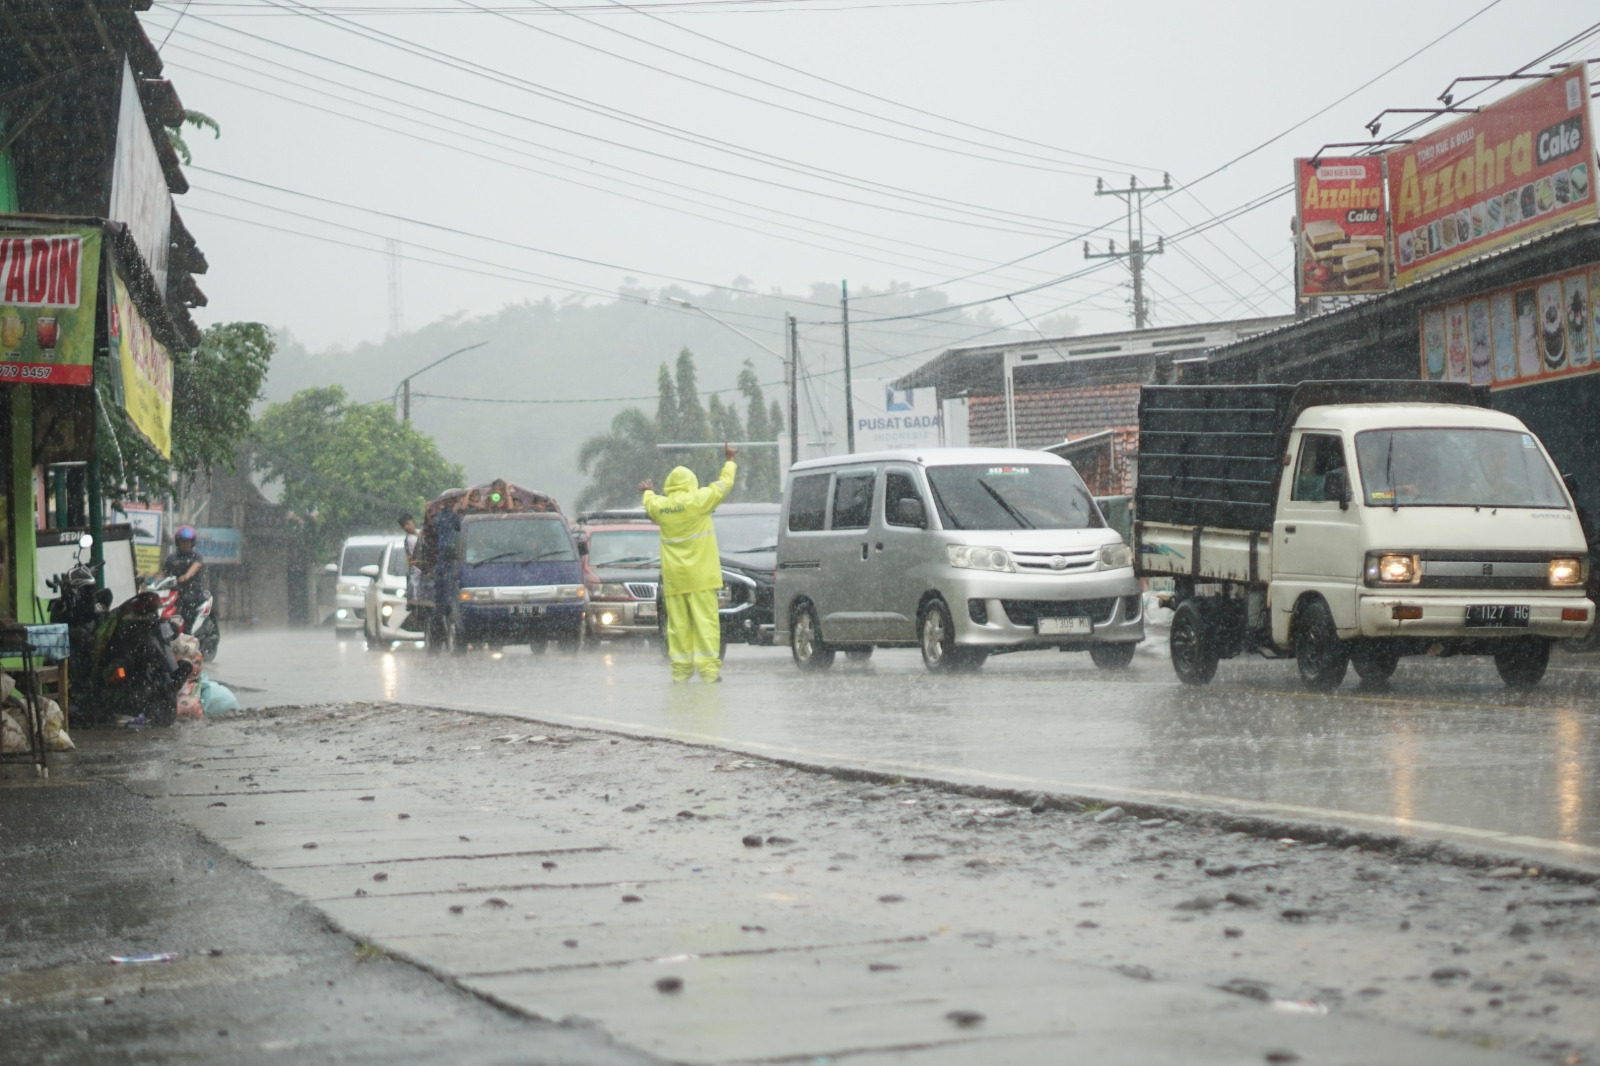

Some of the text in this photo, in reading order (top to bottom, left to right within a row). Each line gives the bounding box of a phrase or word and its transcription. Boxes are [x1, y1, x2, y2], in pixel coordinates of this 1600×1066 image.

[1538, 124, 1581, 162] Cake
[1397, 131, 1533, 225] Azzahra
[1303, 175, 1381, 210] Azzahra
[1347, 209, 1378, 223] Cake
[22, 366, 52, 379] 3457
[858, 417, 900, 431] PUSAT
[1466, 605, 1529, 619] Z 1127 HG
